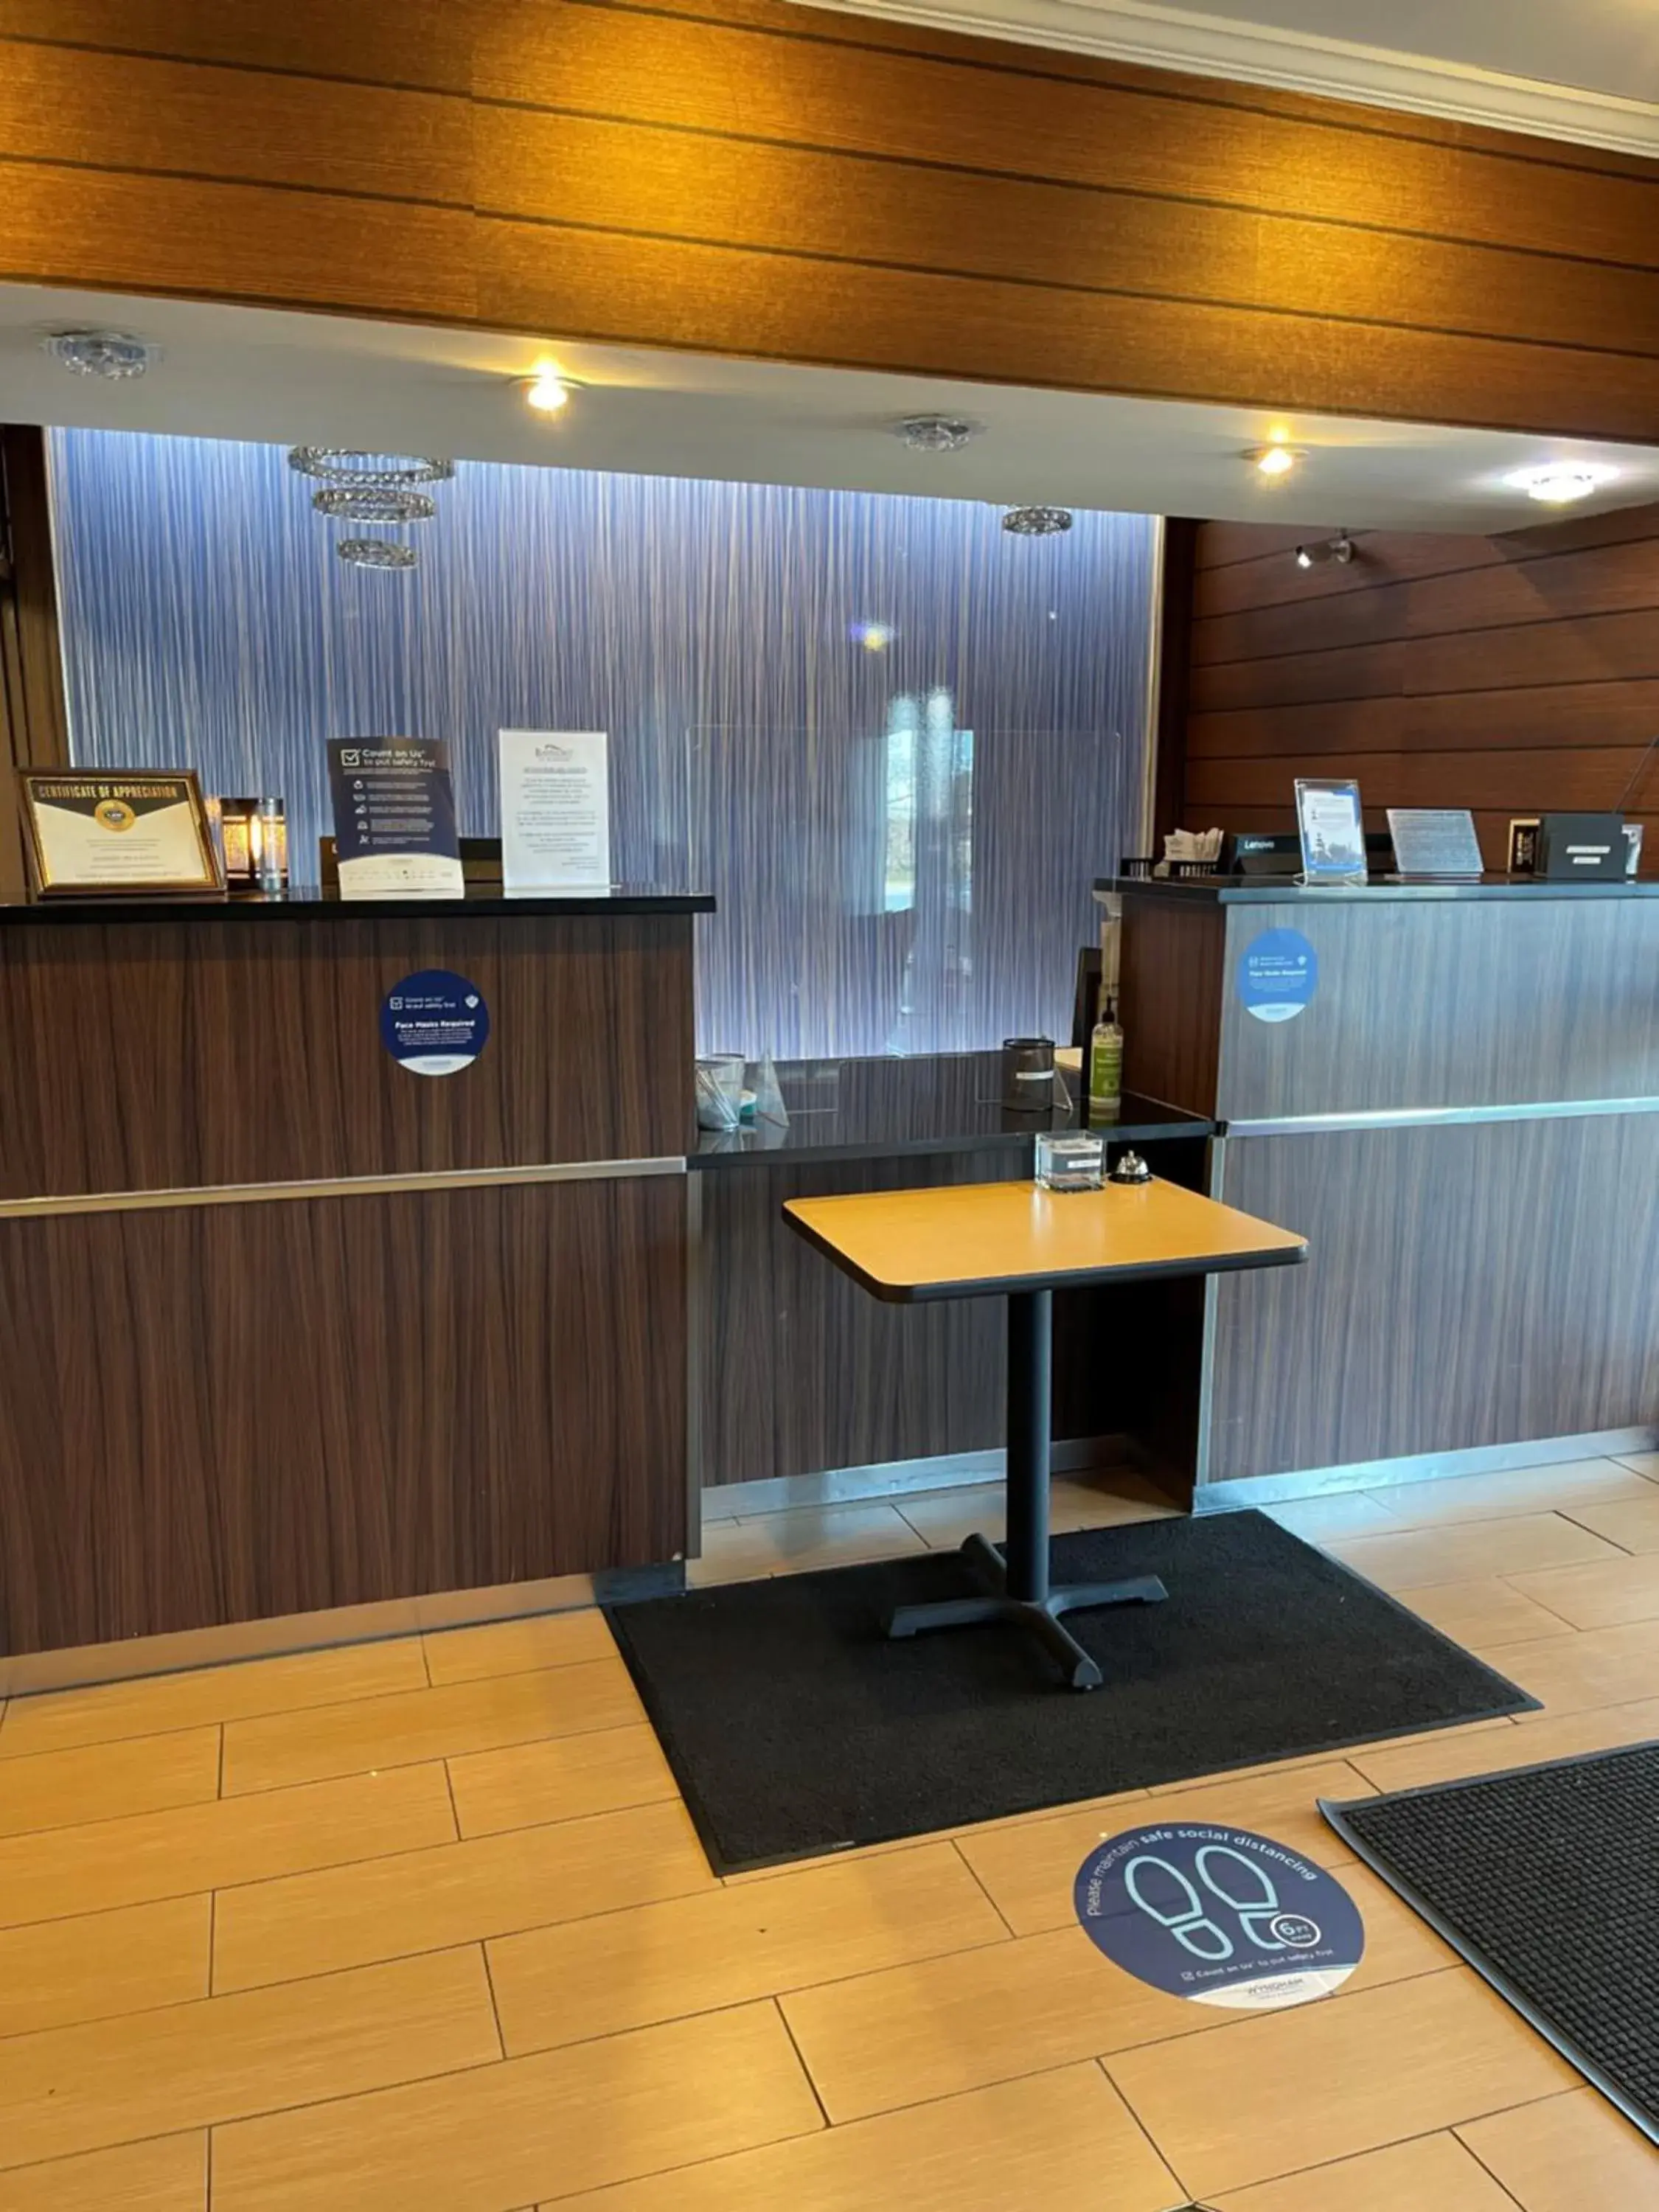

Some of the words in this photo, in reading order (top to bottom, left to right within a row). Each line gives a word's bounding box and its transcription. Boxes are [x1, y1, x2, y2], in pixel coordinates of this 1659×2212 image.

[362, 749, 392, 757] Count
[38, 785, 97, 798] CERTIFICATE
[98, 785, 110, 798] OF
[112, 785, 178, 798] APPRECIATION
[1244, 840, 1275, 849] Lenovo
[440, 1020, 476, 1028] Required
[1140, 1830, 1173, 1843] safe
[1177, 1829, 1229, 1841] social
[1093, 1840, 1140, 1878] maintain
[1234, 1836, 1318, 1880] distancing
[1086, 1878, 1103, 1916] Please
[1279, 1922, 1295, 1935] 6
[1196, 1967, 1225, 1978] Count
